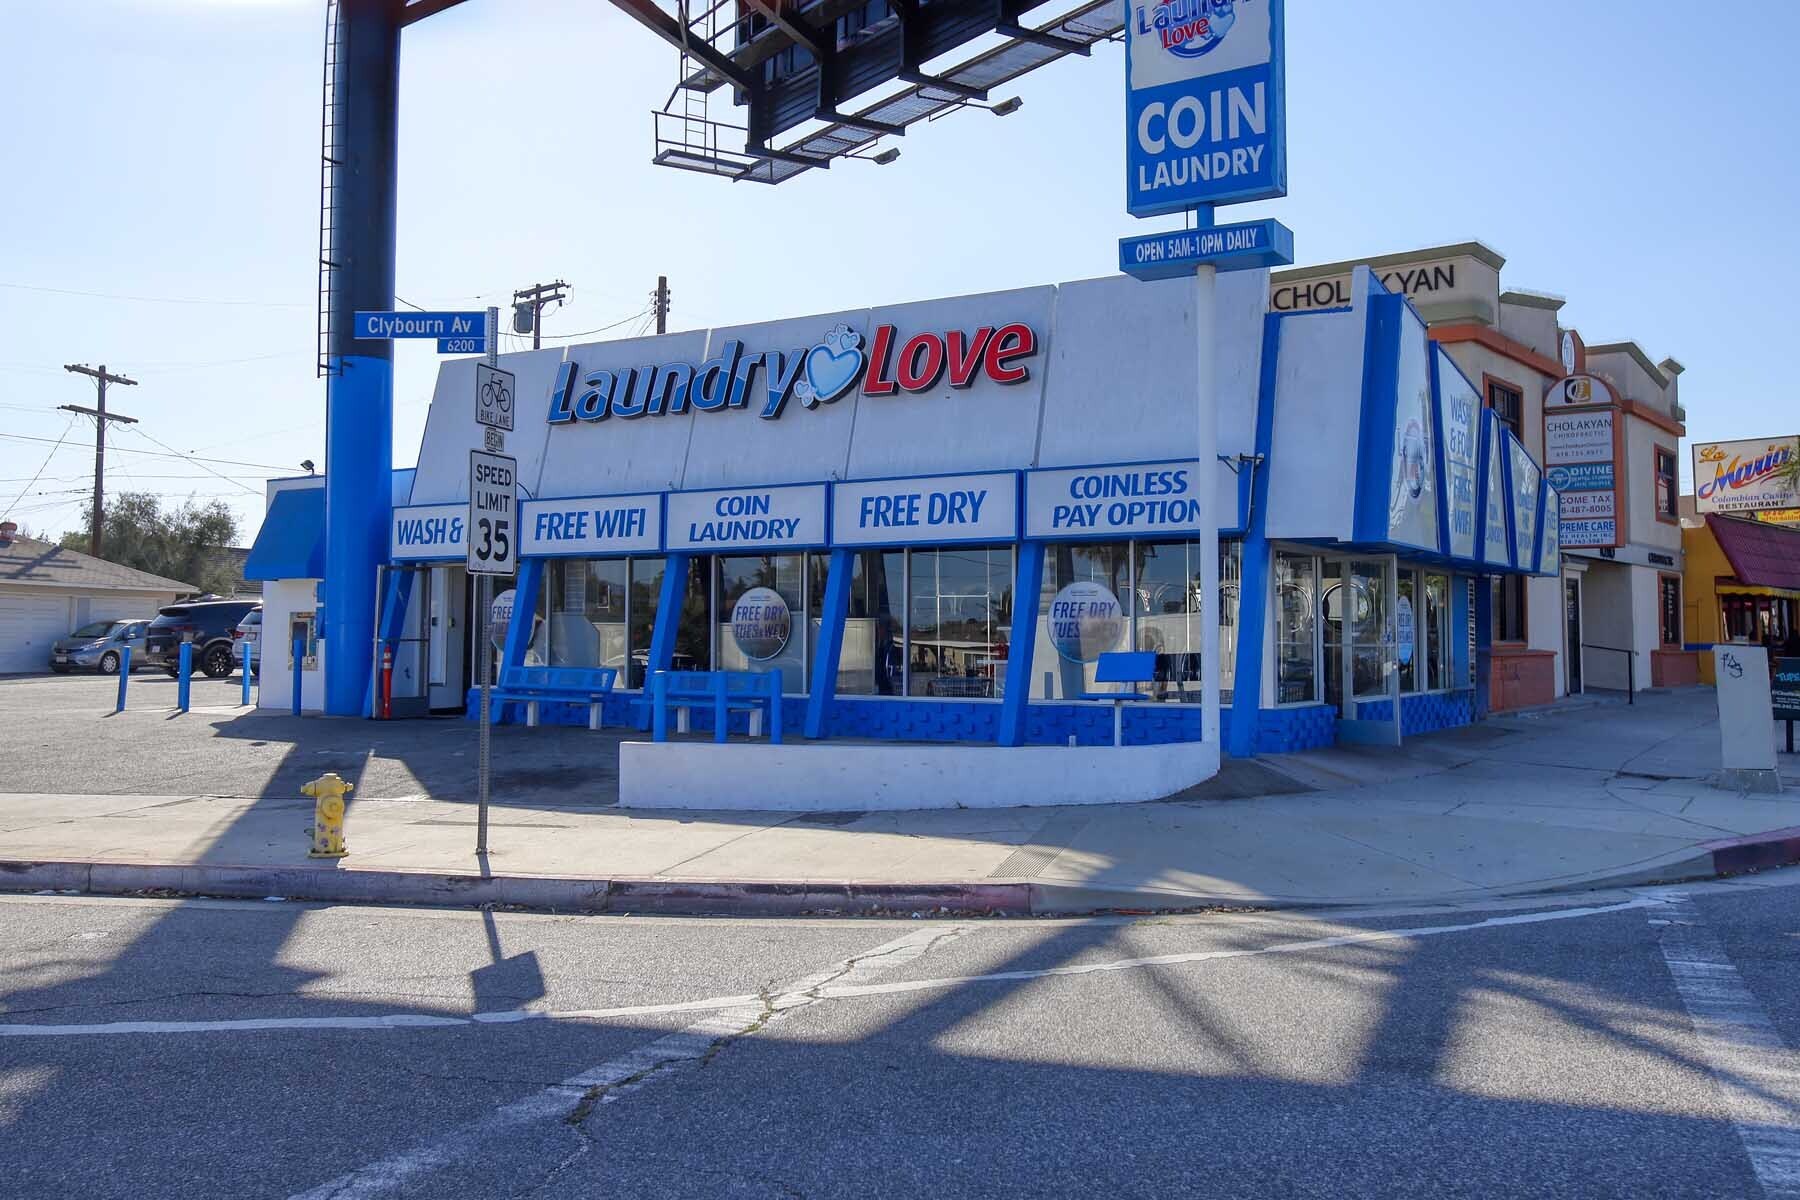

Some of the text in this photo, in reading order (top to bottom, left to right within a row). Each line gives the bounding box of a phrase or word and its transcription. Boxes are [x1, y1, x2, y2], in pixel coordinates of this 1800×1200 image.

[1136, 0, 1252, 35] Laun
[1161, 18, 1210, 49] Love
[1137, 81, 1266, 154] COIN
[1139, 144, 1264, 192] LAUNDRY
[1136, 228, 1257, 264] OPEN 5AM-10PM DAILY
[1273, 264, 1455, 311] CHOLYAN
[367, 316, 472, 338] Clybourn Av
[447, 340, 475, 352] 6200
[861, 322, 1039, 398] Love
[547, 338, 808, 426] Laundry
[480, 408, 510, 428] BIKE LANE
[1547, 418, 1612, 432] CHOLAKYAN
[485, 430, 504, 448] BEGIN
[475, 463, 512, 487] SPEED
[1570, 465, 1613, 476] DIVINE
[1069, 470, 1189, 499] COINLESS
[477, 490, 510, 513] LIMIT
[715, 494, 771, 517] COIN
[859, 490, 988, 528] FREE DRY
[1560, 495, 1611, 504] COME TAX
[1718, 500, 1785, 510] RESTAURANT
[534, 508, 647, 541] FREE WIFI
[1052, 499, 1200, 528] PAY OPTION
[397, 517, 464, 546] WASH &
[689, 517, 801, 542] LAUNDRY
[1560, 520, 1614, 532] PREME CARE
[475, 517, 509, 562] 35
[492, 606, 512, 619] FREE
[736, 605, 785, 621] FREE DRY
[1053, 601, 1116, 618] FREE DRY
